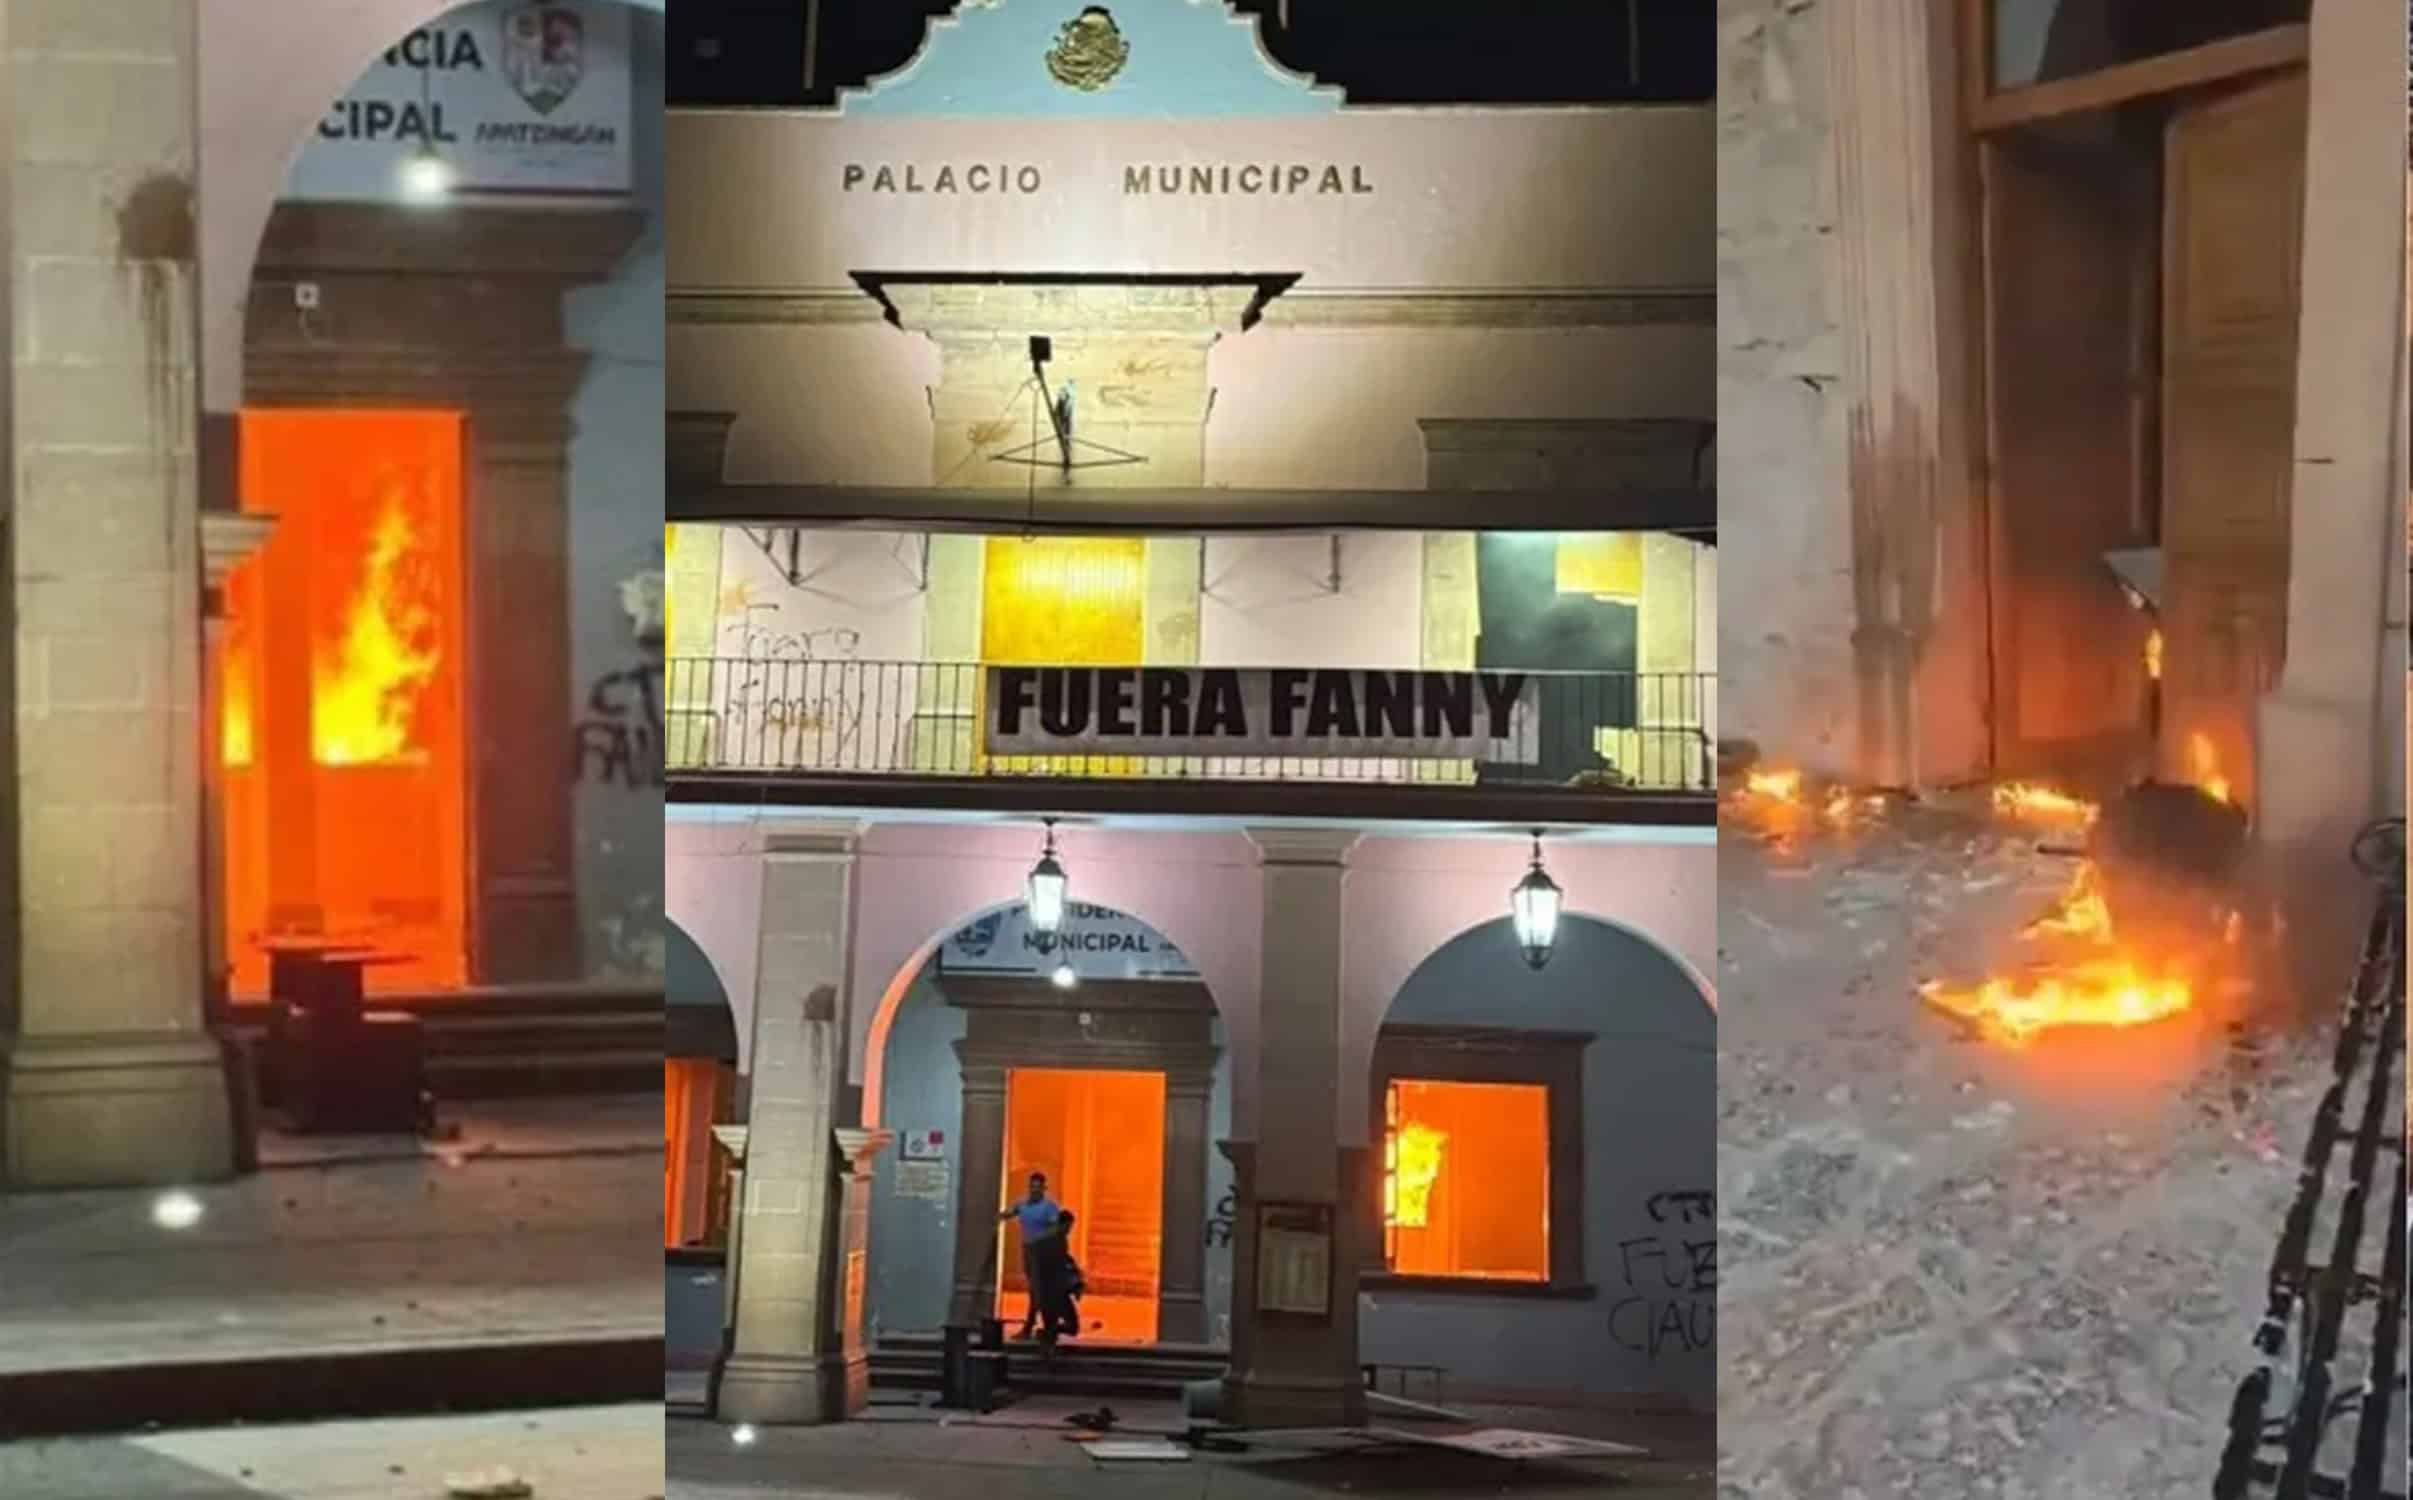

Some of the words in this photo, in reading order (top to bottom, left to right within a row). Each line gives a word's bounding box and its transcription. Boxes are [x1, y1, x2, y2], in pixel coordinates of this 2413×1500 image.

[842, 164, 1042, 193] PALACIO
[1124, 164, 1375, 194] MUNICIPAL
[997, 668, 1248, 736] FUERA
[1269, 669, 1527, 738] FANNY
[1022, 931, 1151, 953] MUNICIPAL
